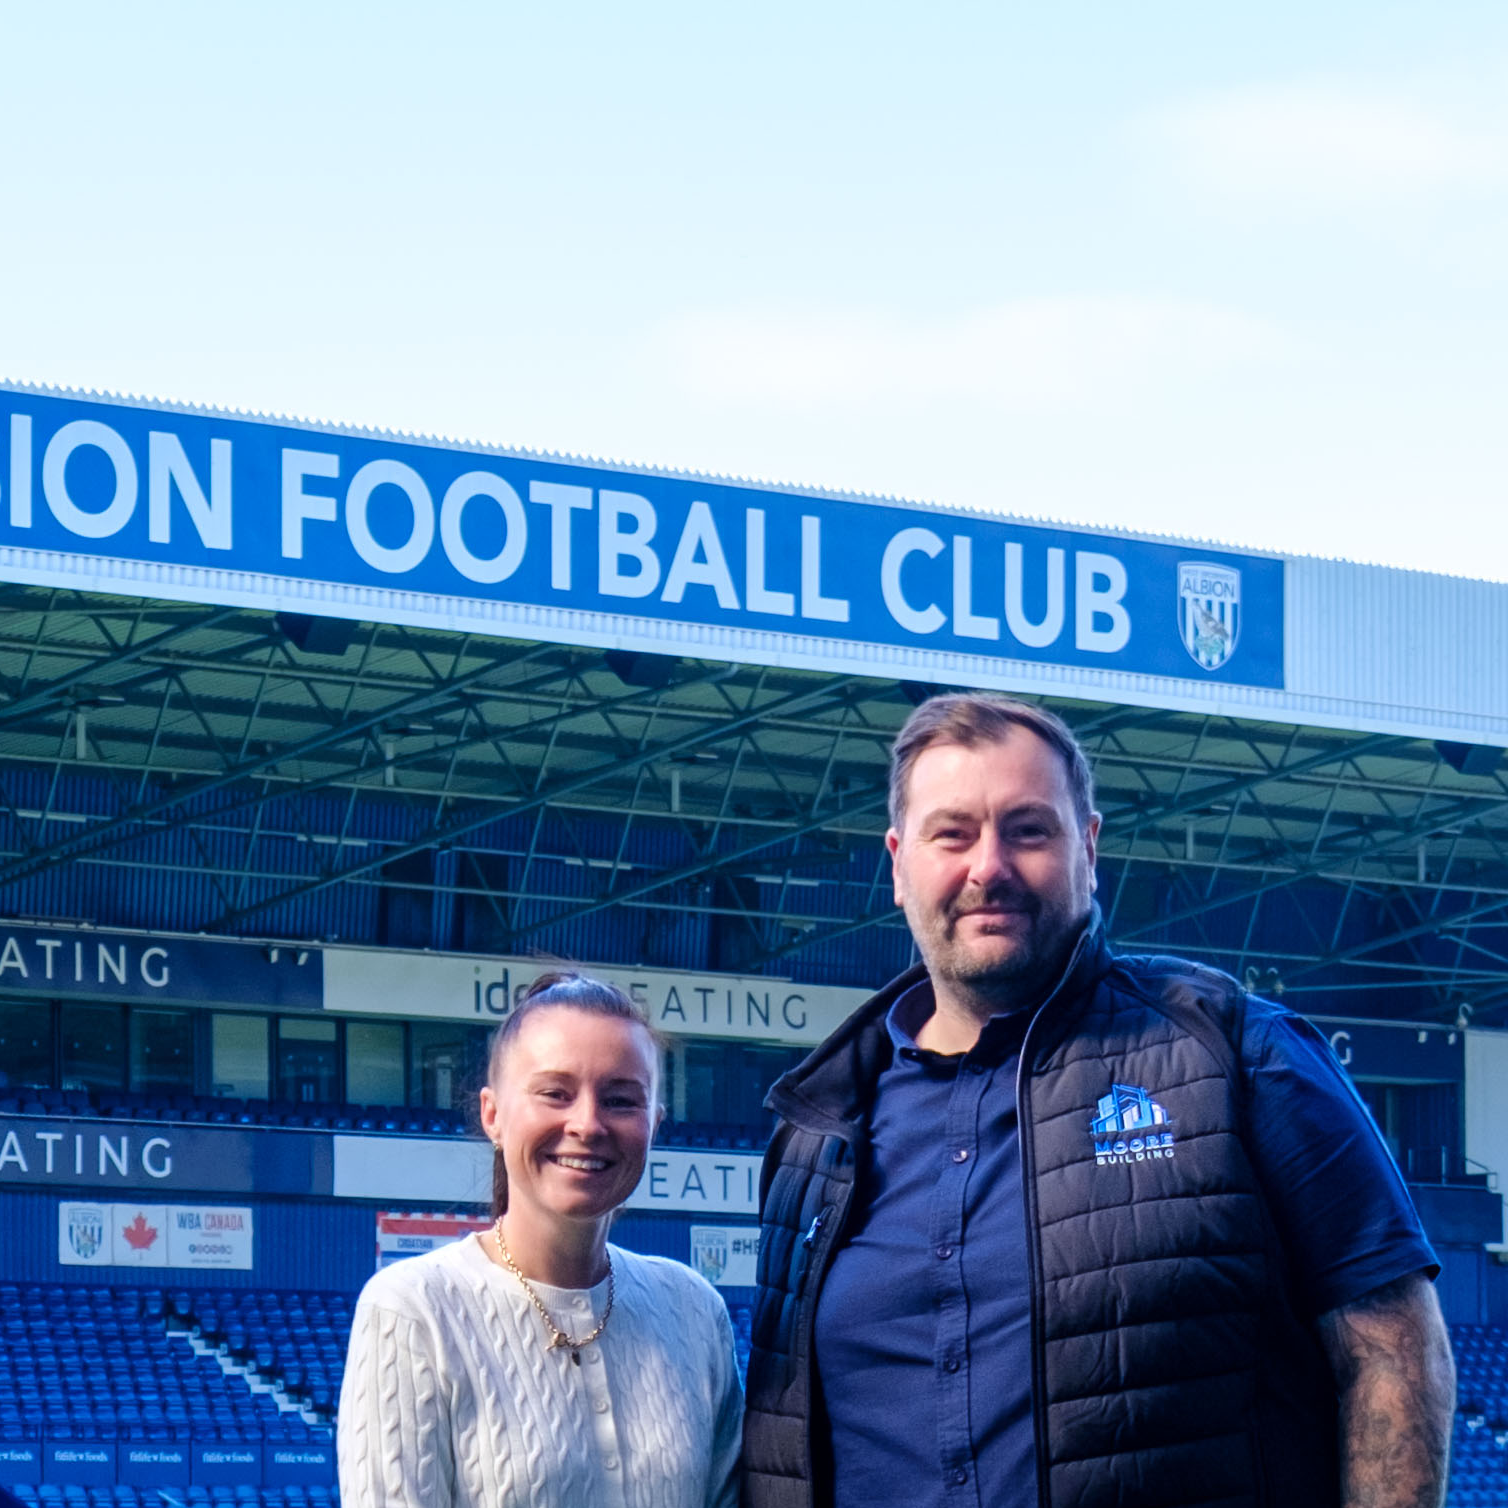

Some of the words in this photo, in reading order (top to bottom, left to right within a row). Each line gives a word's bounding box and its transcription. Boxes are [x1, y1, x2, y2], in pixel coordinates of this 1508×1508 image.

[281, 448, 850, 623] FOOTBALL
[881, 527, 1131, 654] CLUB
[1182, 577, 1235, 598] ALBION
[631, 983, 807, 1029] EATING
[1094, 1133, 1174, 1156] MOORE
[1096, 1149, 1175, 1166] BUILDING
[649, 1162, 752, 1202] EATI
[176, 1212, 202, 1230] WBA
[204, 1213, 244, 1231] CANADA
